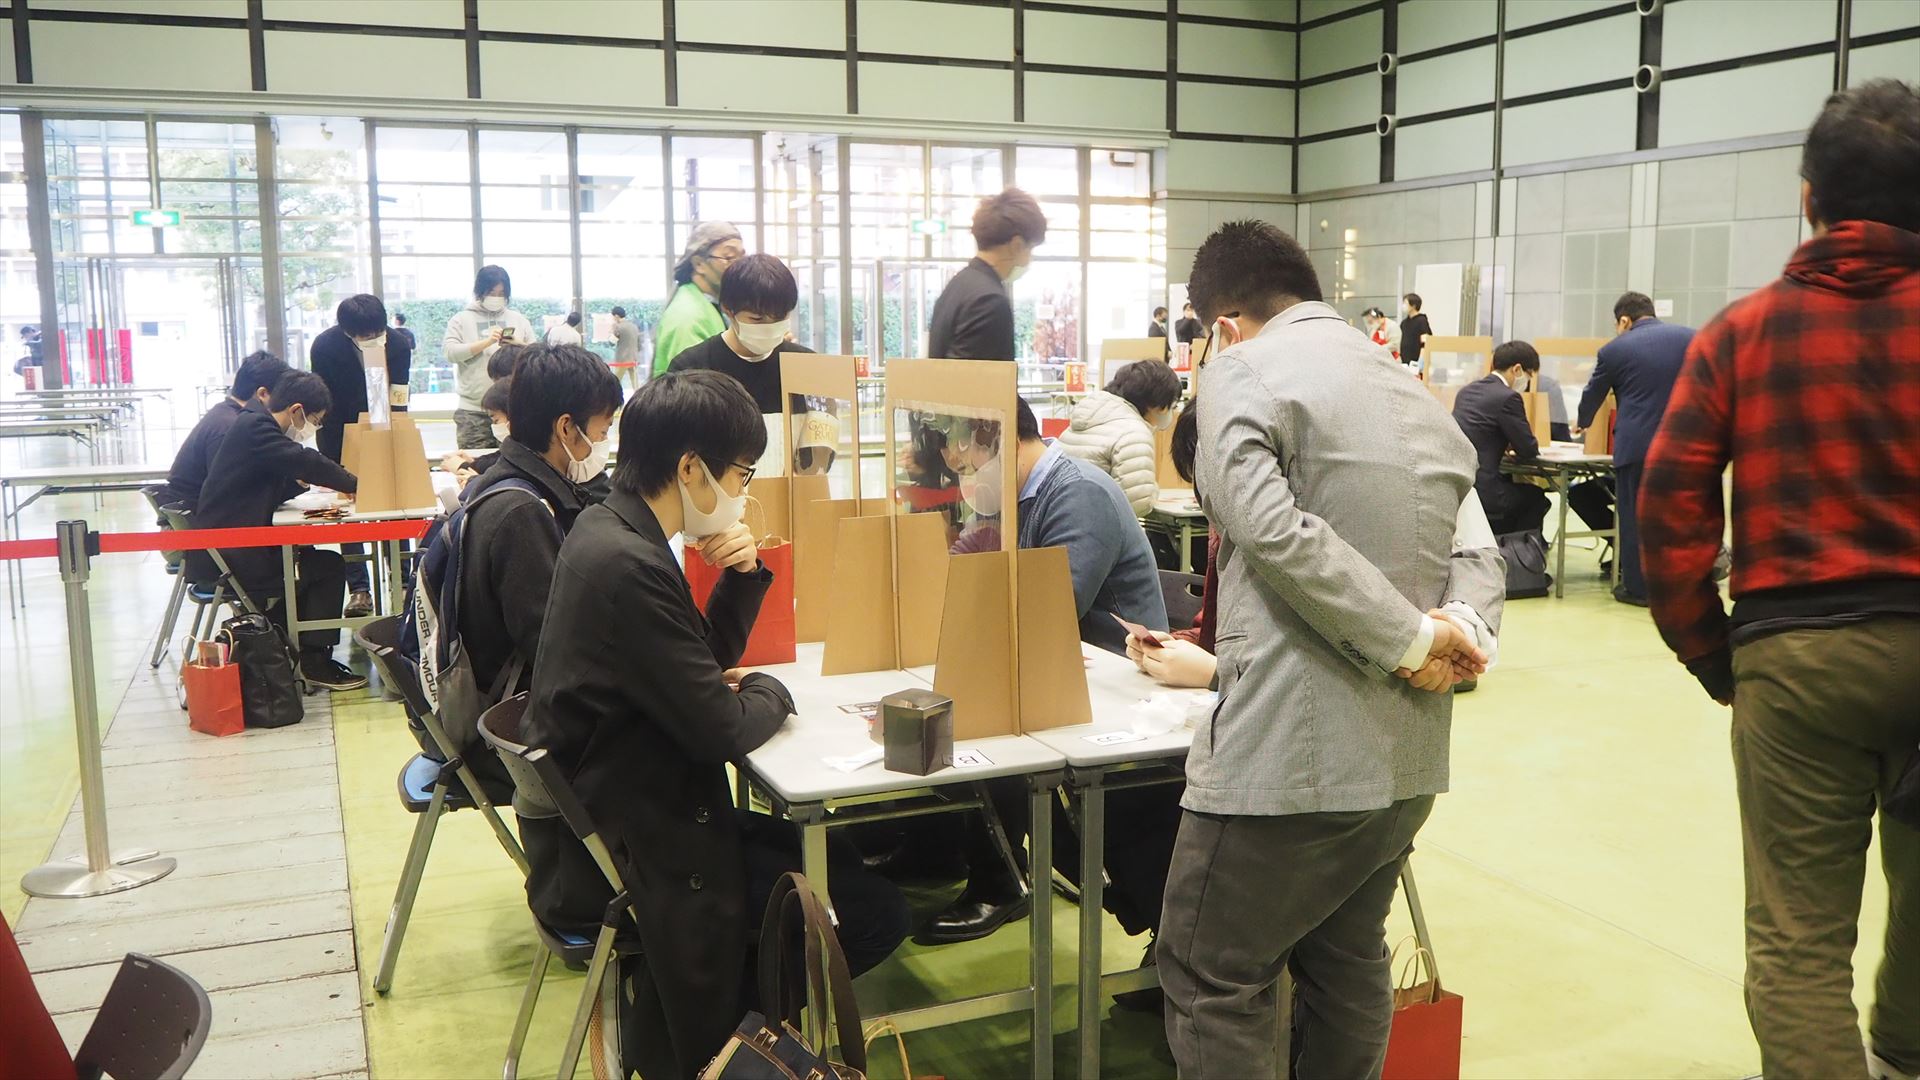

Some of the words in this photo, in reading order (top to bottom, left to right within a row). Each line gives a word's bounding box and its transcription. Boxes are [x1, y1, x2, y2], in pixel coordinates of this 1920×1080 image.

[814, 430, 833, 441] RUL
[415, 589, 431, 638] UNDER
[420, 643, 438, 702] MOUR
